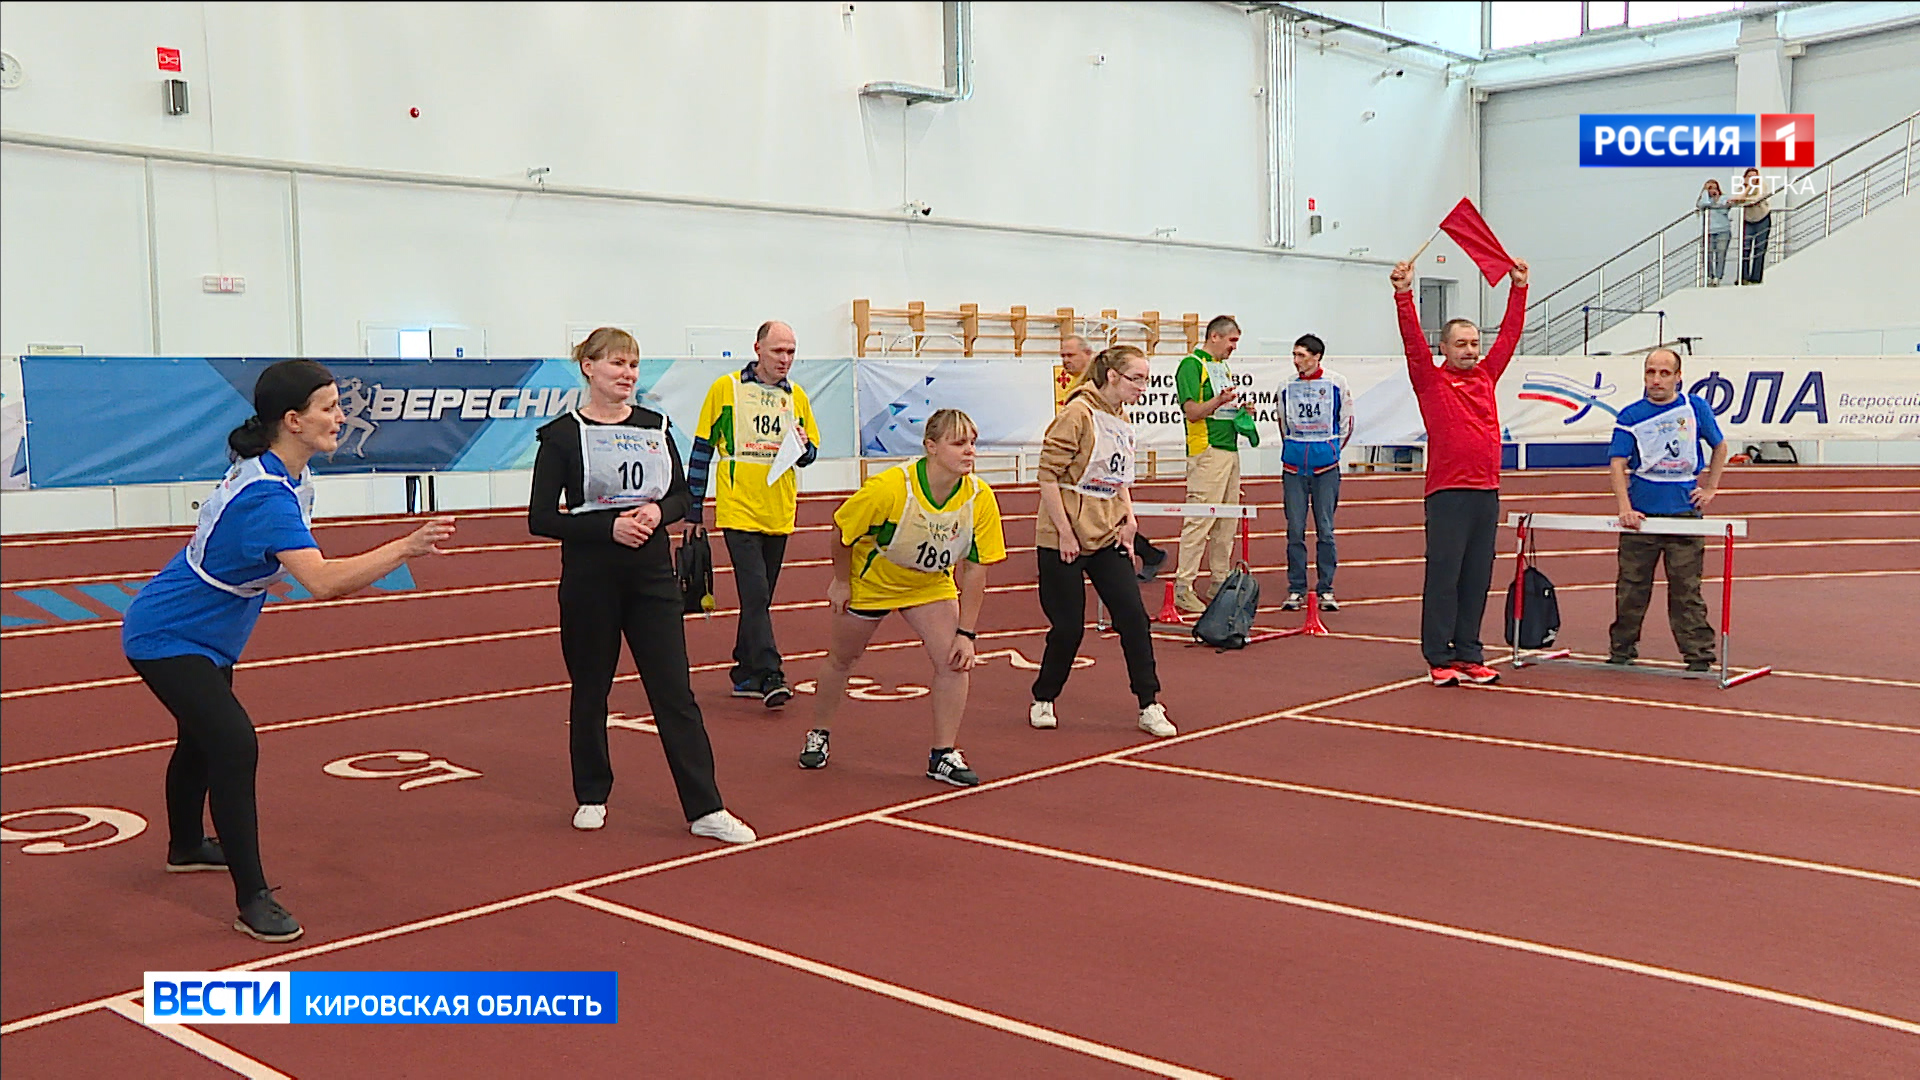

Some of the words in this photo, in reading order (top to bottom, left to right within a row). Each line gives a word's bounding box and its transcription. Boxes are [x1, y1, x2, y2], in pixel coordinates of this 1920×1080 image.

[1298, 402, 1321, 418] 284
[1643, 371, 1828, 423] ФЛА
[753, 414, 781, 436] 184
[618, 461, 644, 490] 10
[915, 541, 951, 569] 189
[322, 749, 484, 791] 5
